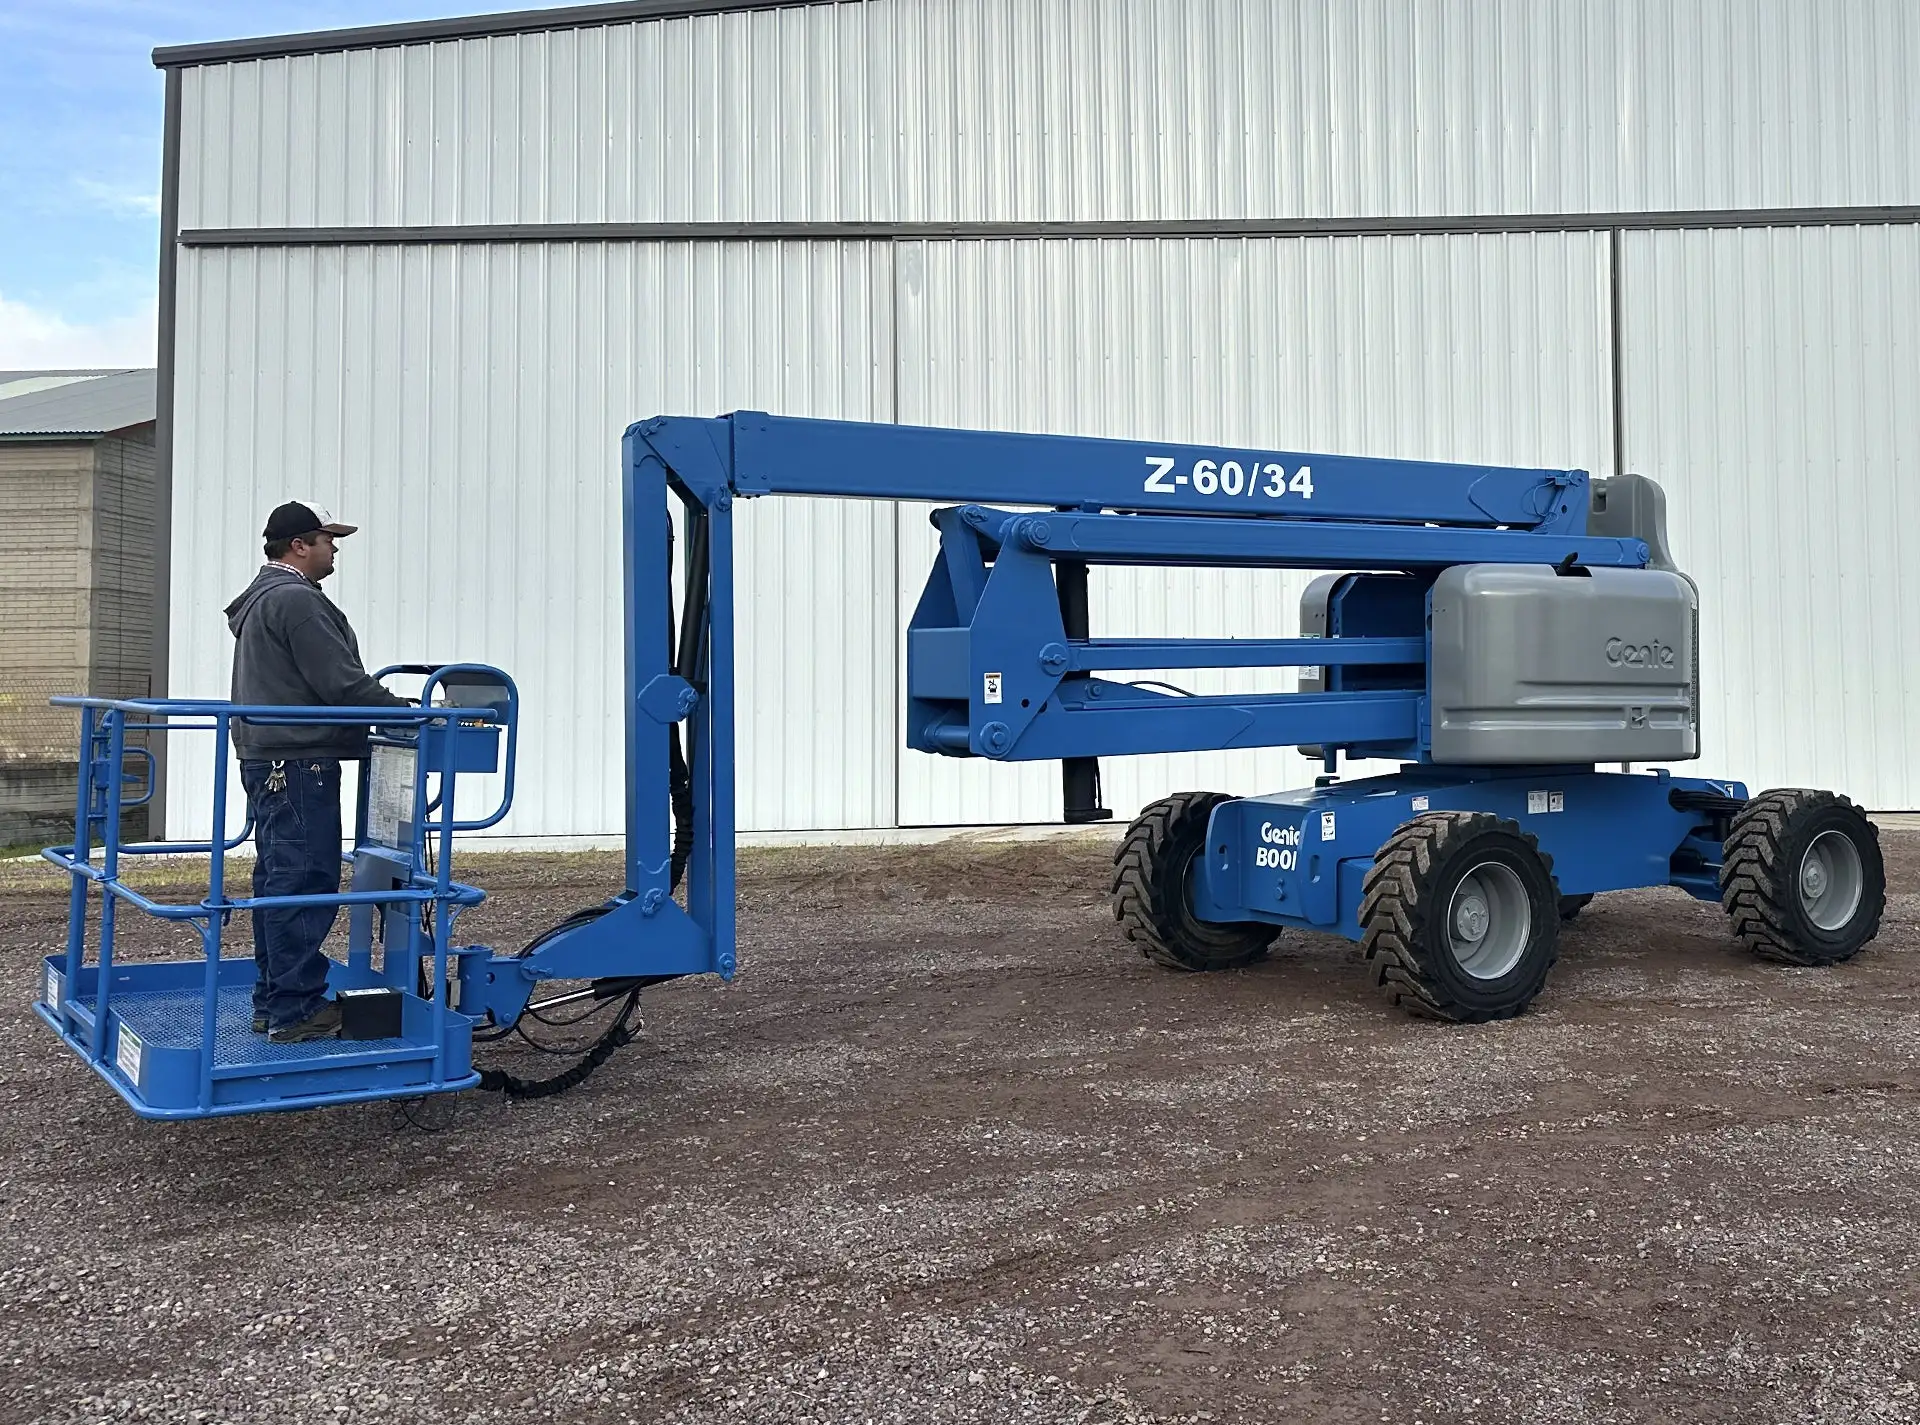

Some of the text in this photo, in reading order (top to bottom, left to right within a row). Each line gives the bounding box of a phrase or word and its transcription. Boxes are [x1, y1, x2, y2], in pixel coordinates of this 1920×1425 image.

[1144, 456, 1314, 499] Z-60/34
[1605, 636, 1674, 669] Genie
[1256, 847, 1297, 871] BOO
